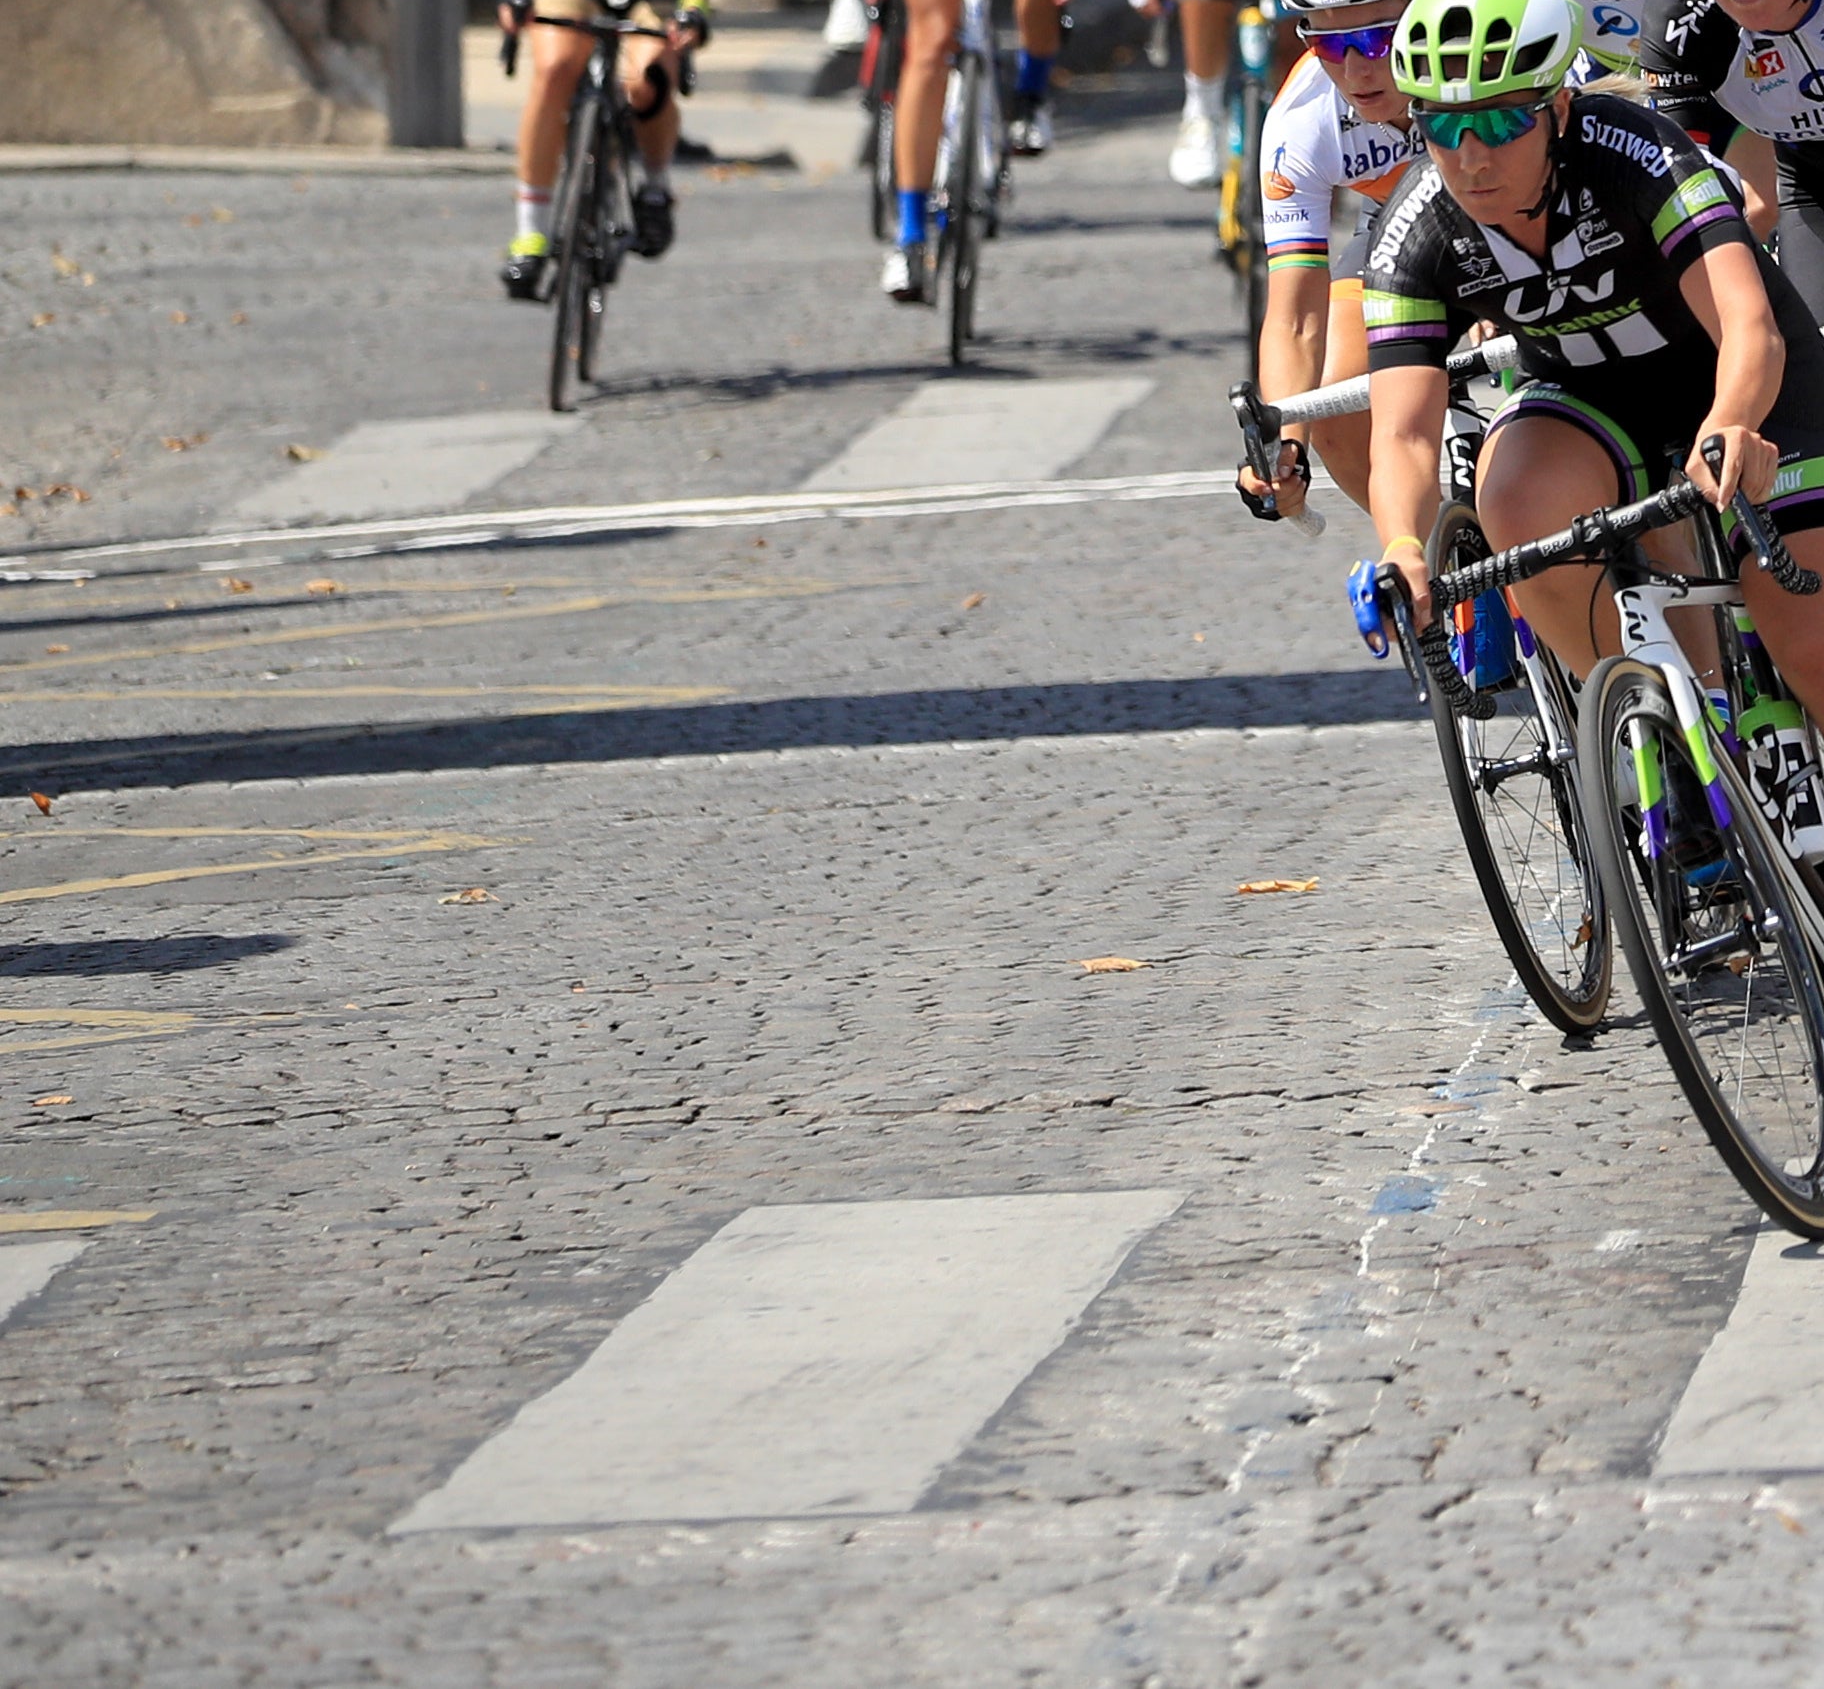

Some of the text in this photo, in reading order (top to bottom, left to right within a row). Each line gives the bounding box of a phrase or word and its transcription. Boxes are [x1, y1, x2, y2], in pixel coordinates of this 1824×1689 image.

[1580, 114, 1676, 178] Sunweb
[1369, 168, 1444, 274] Sunweb
[1503, 268, 1615, 323] Liv
[1442, 437, 1475, 489] Liv
[1541, 535, 1574, 556] PRO
[1611, 510, 1641, 529] PRO
[1621, 590, 1648, 643] Liv
